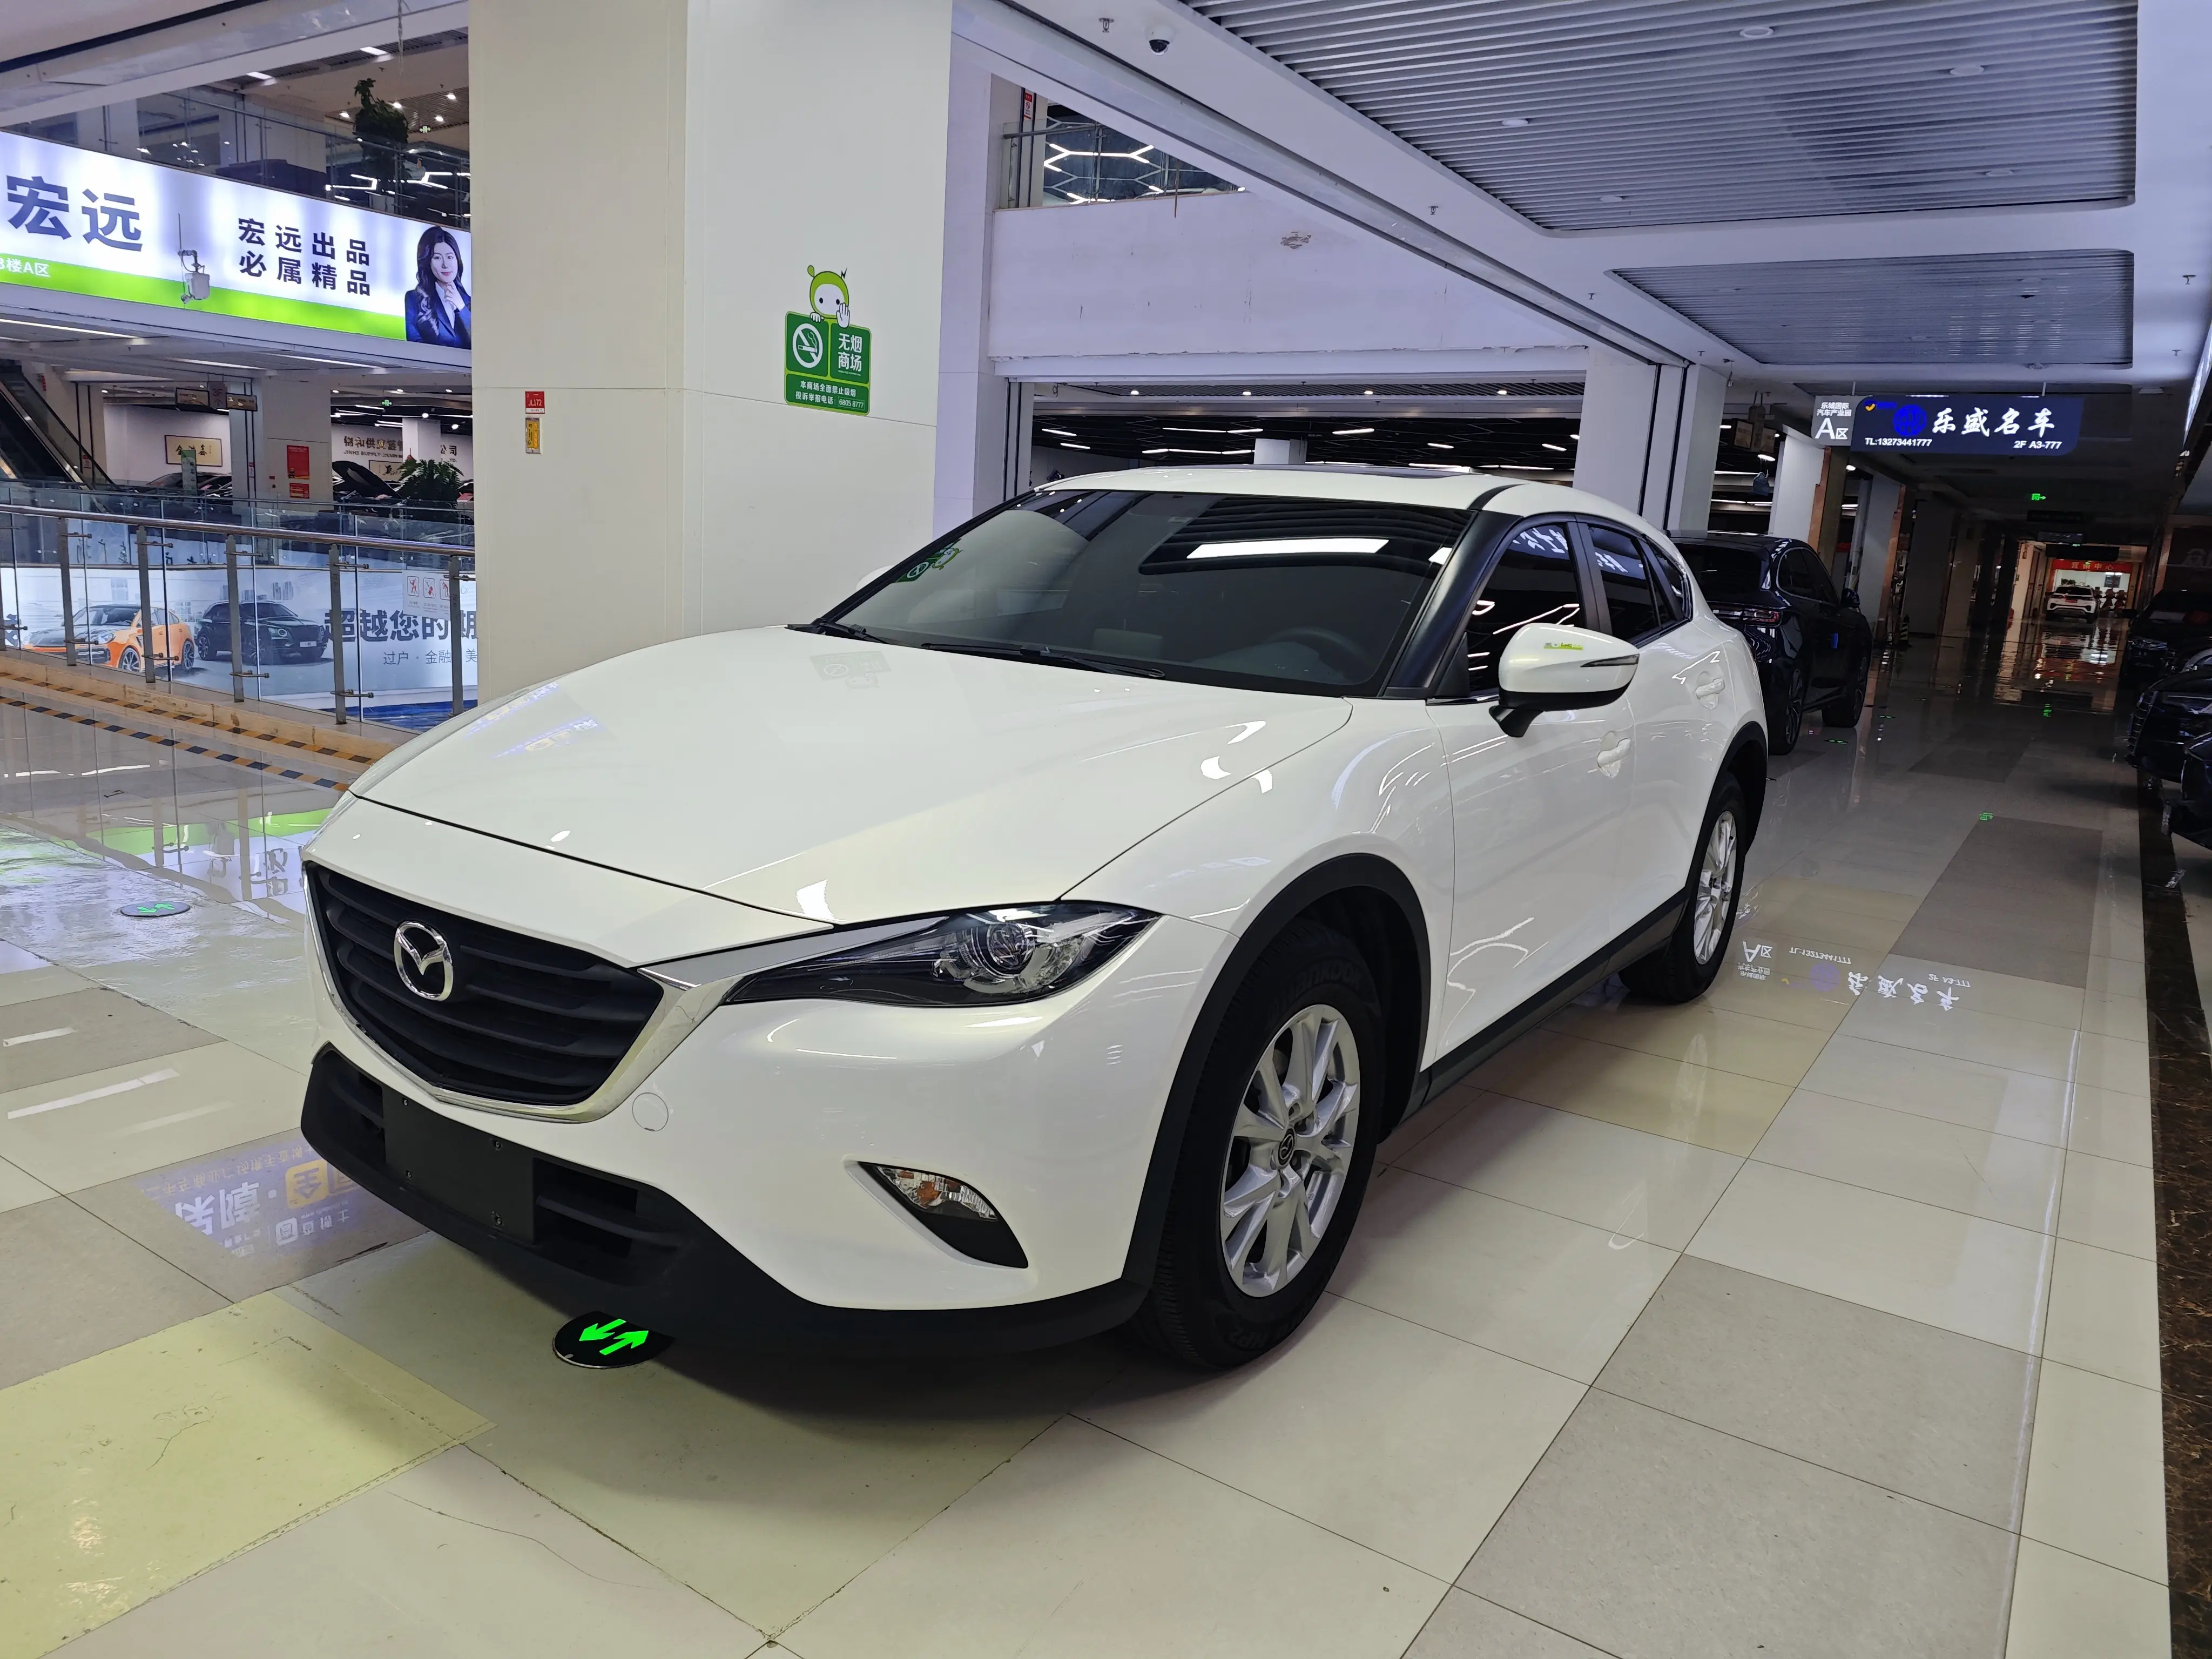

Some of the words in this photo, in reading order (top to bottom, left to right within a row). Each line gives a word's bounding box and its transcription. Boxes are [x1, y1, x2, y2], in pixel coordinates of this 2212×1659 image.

[6, 176, 143, 252] 宏远
[238, 218, 370, 267] 宏远出品
[239, 250, 371, 296] 必属精品
[838, 333, 862, 353] 无烟
[838, 352, 862, 372] 商场
[800, 380, 857, 397] 本商场全面禁止吸烟
[1815, 417, 1849, 440] A区
[1932, 407, 2055, 439] 乐盛名车
[1865, 437, 1933, 447] TL:13273441777
[2013, 440, 2027, 449] 2F
[2028, 441, 2062, 449] A3-777
[383, 651, 409, 665] 过户
[425, 650, 452, 664] 金融
